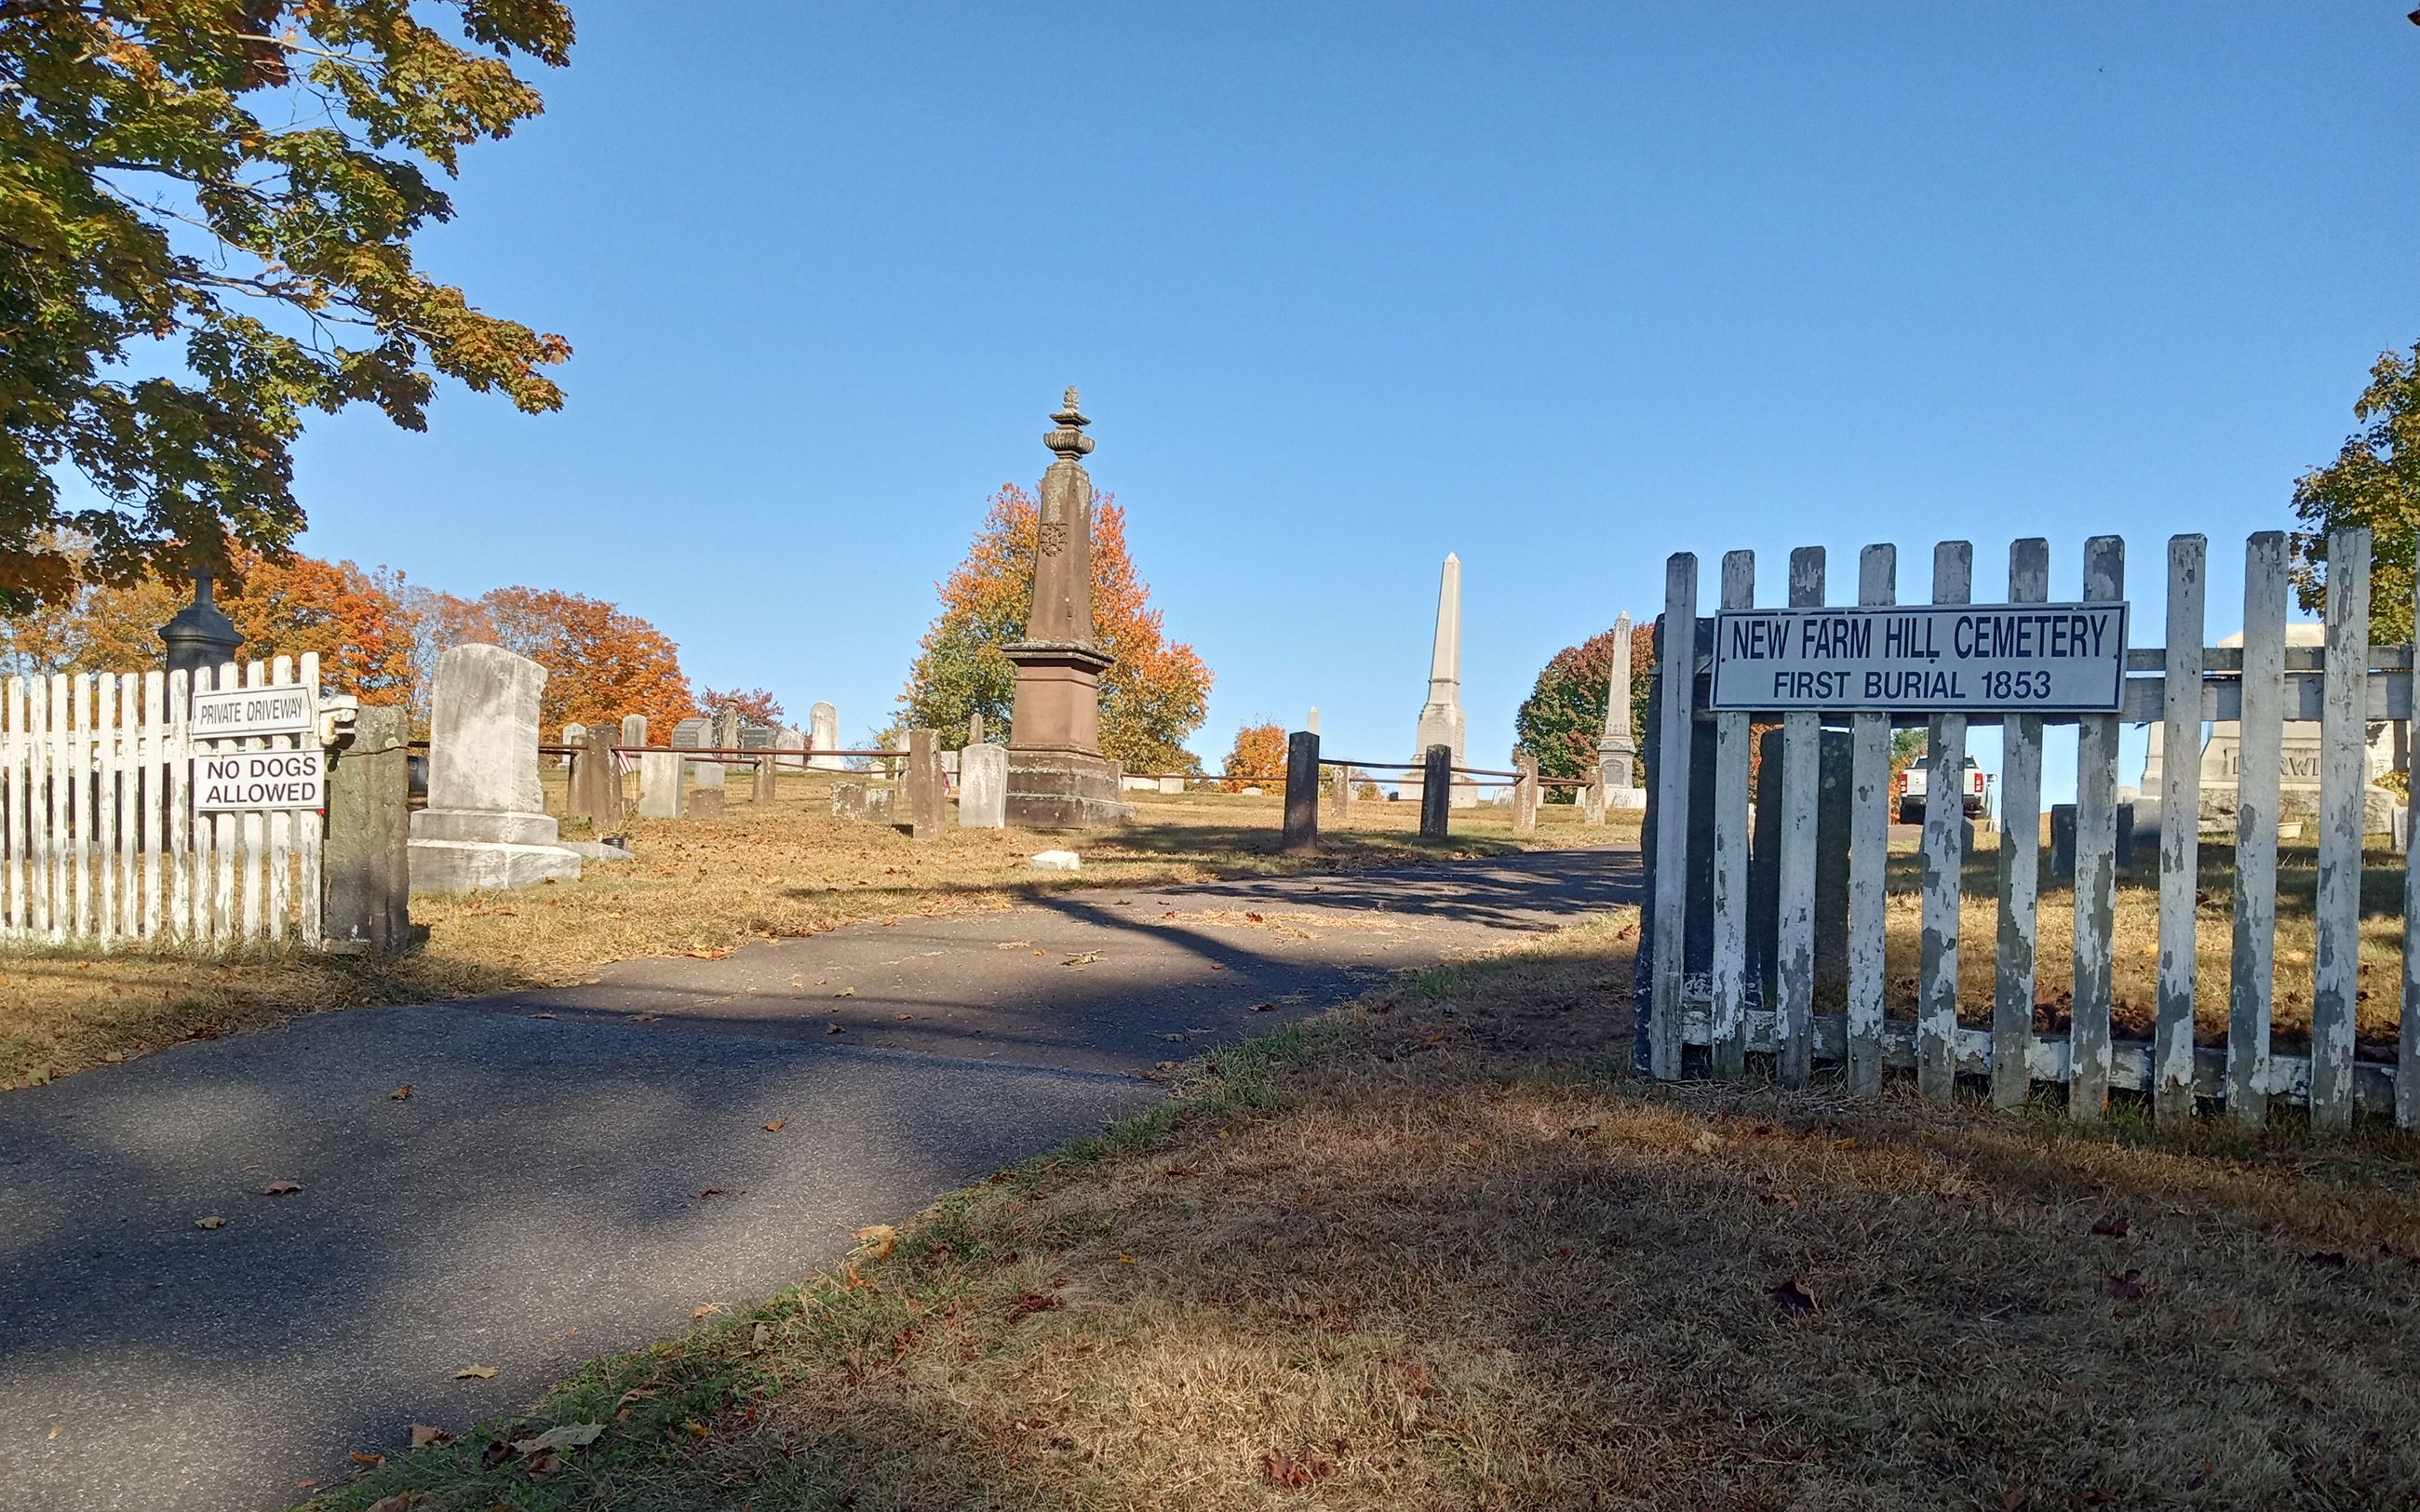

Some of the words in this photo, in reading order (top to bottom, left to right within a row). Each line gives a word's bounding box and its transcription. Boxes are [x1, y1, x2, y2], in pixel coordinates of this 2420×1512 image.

[1732, 620, 1790, 659] NEW
[1802, 618, 1872, 659] FARM
[1885, 618, 1940, 658] HILL
[1955, 615, 2107, 659] CEMETERY
[1774, 671, 1850, 698] FIRST
[1864, 671, 1966, 698] BURIAL
[1982, 670, 2050, 699] 1853
[200, 702, 241, 725] PRIVATE
[248, 697, 302, 721] DRIVEWAY
[207, 760, 239, 779] NO
[250, 756, 316, 778] DOGS
[206, 783, 316, 803] ALLOWED
